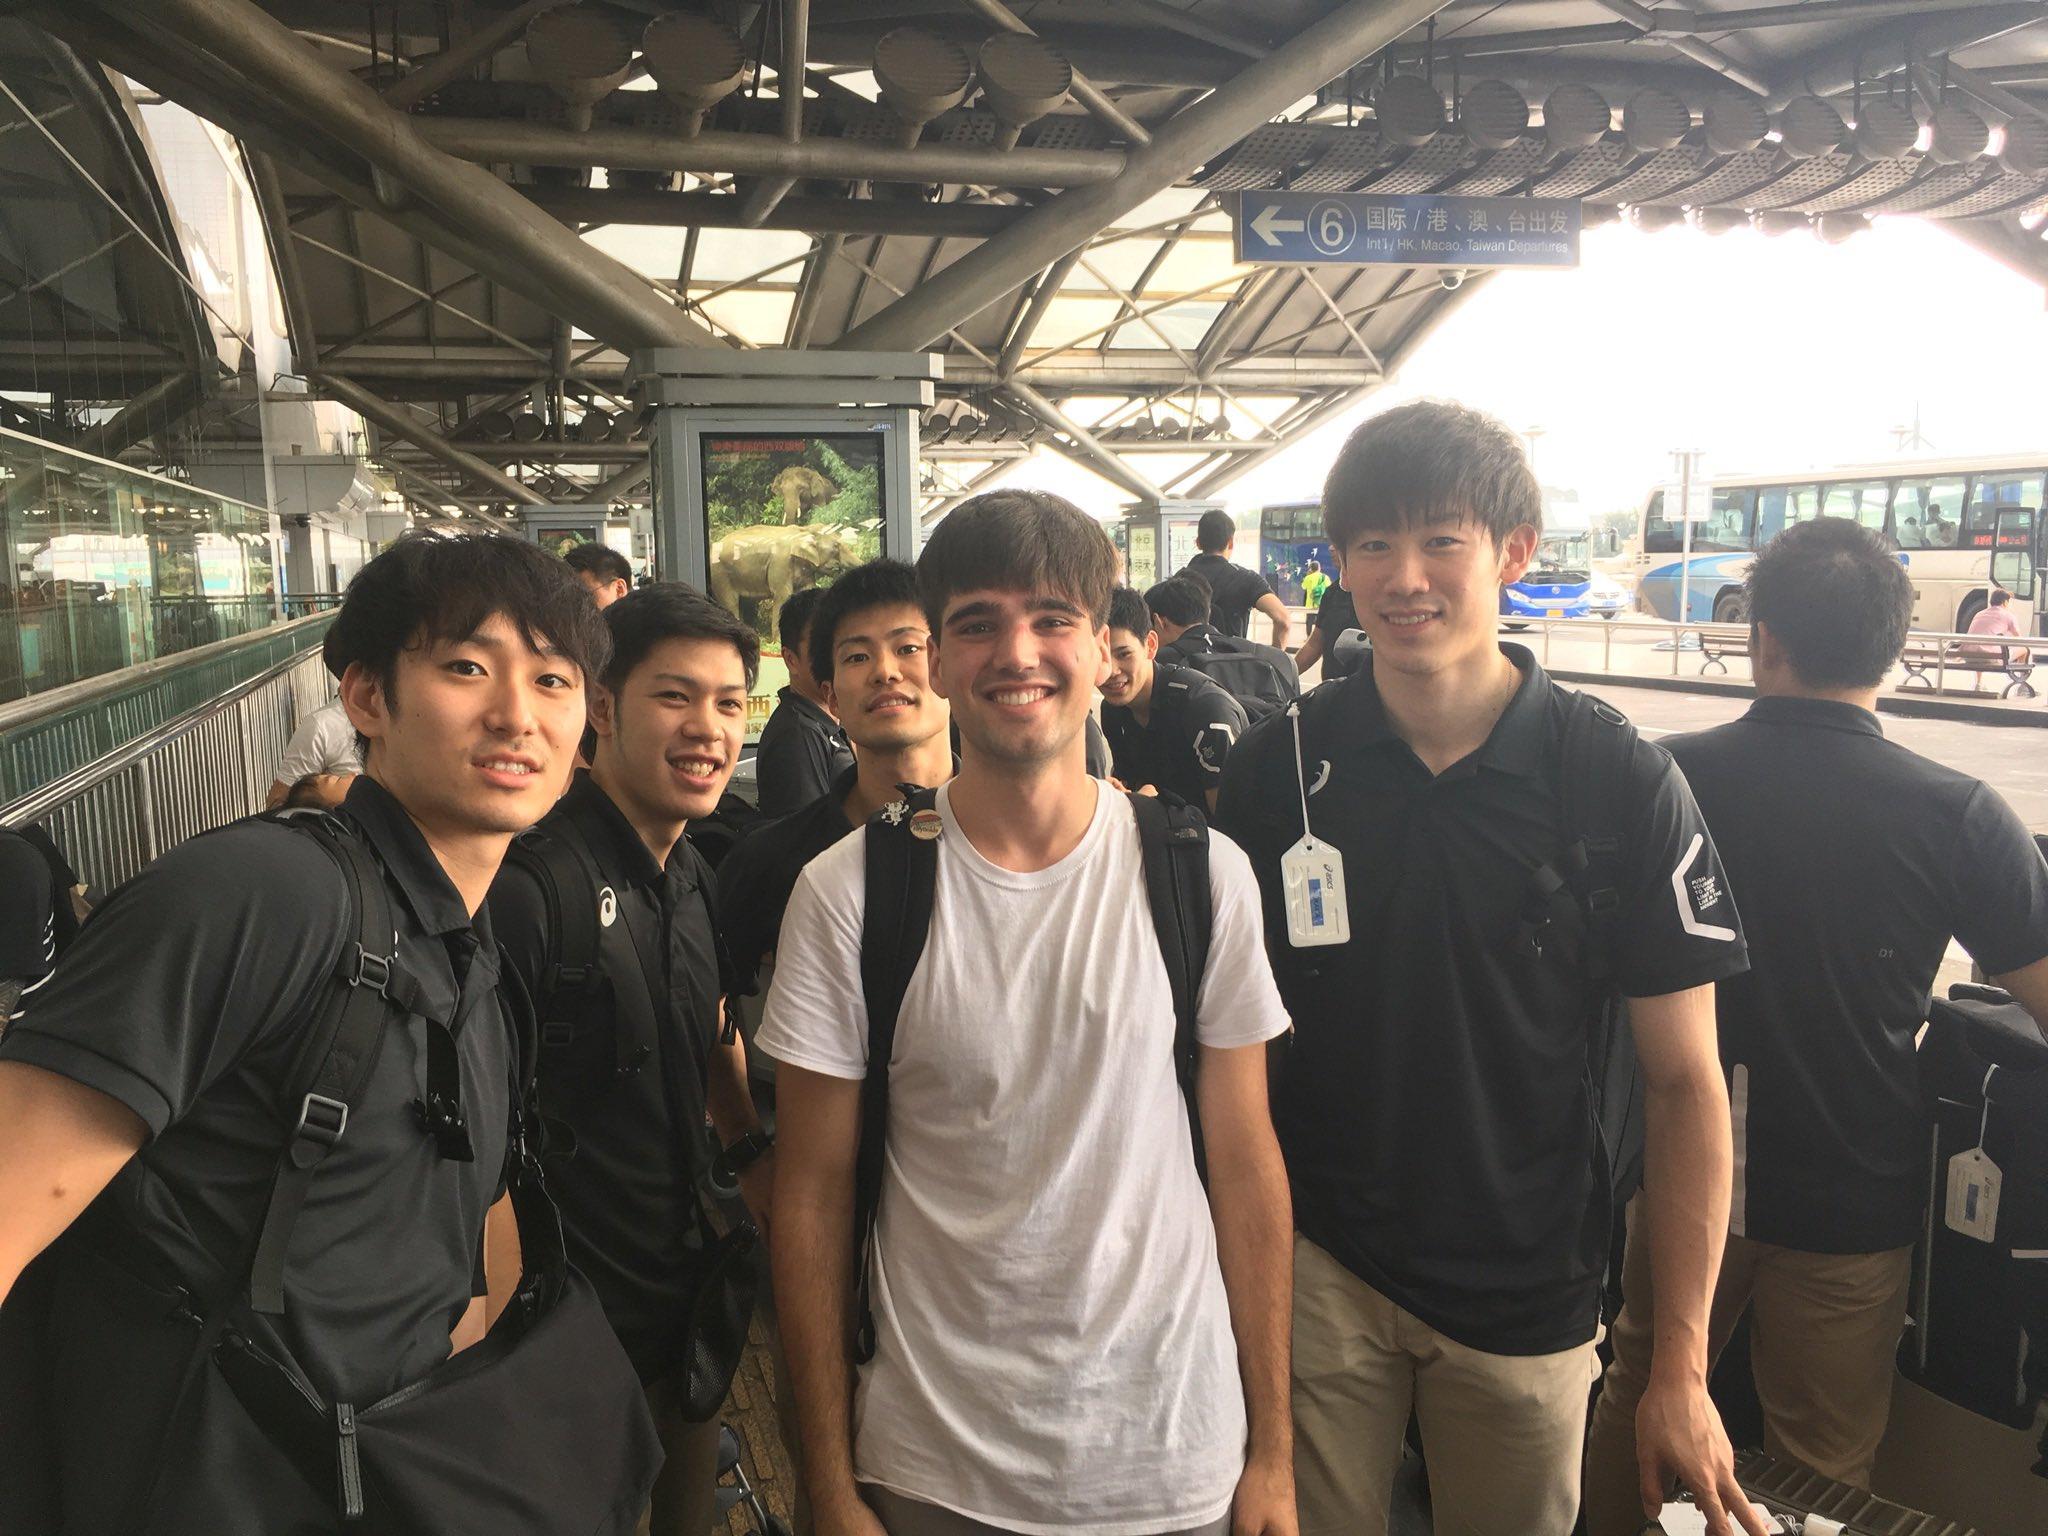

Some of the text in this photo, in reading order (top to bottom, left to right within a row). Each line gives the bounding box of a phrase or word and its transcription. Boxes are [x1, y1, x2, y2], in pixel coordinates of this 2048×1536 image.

[1320, 208, 1345, 246] 6
[1467, 239, 1505, 252] Taiwan
[1508, 240, 1569, 255] Departures
